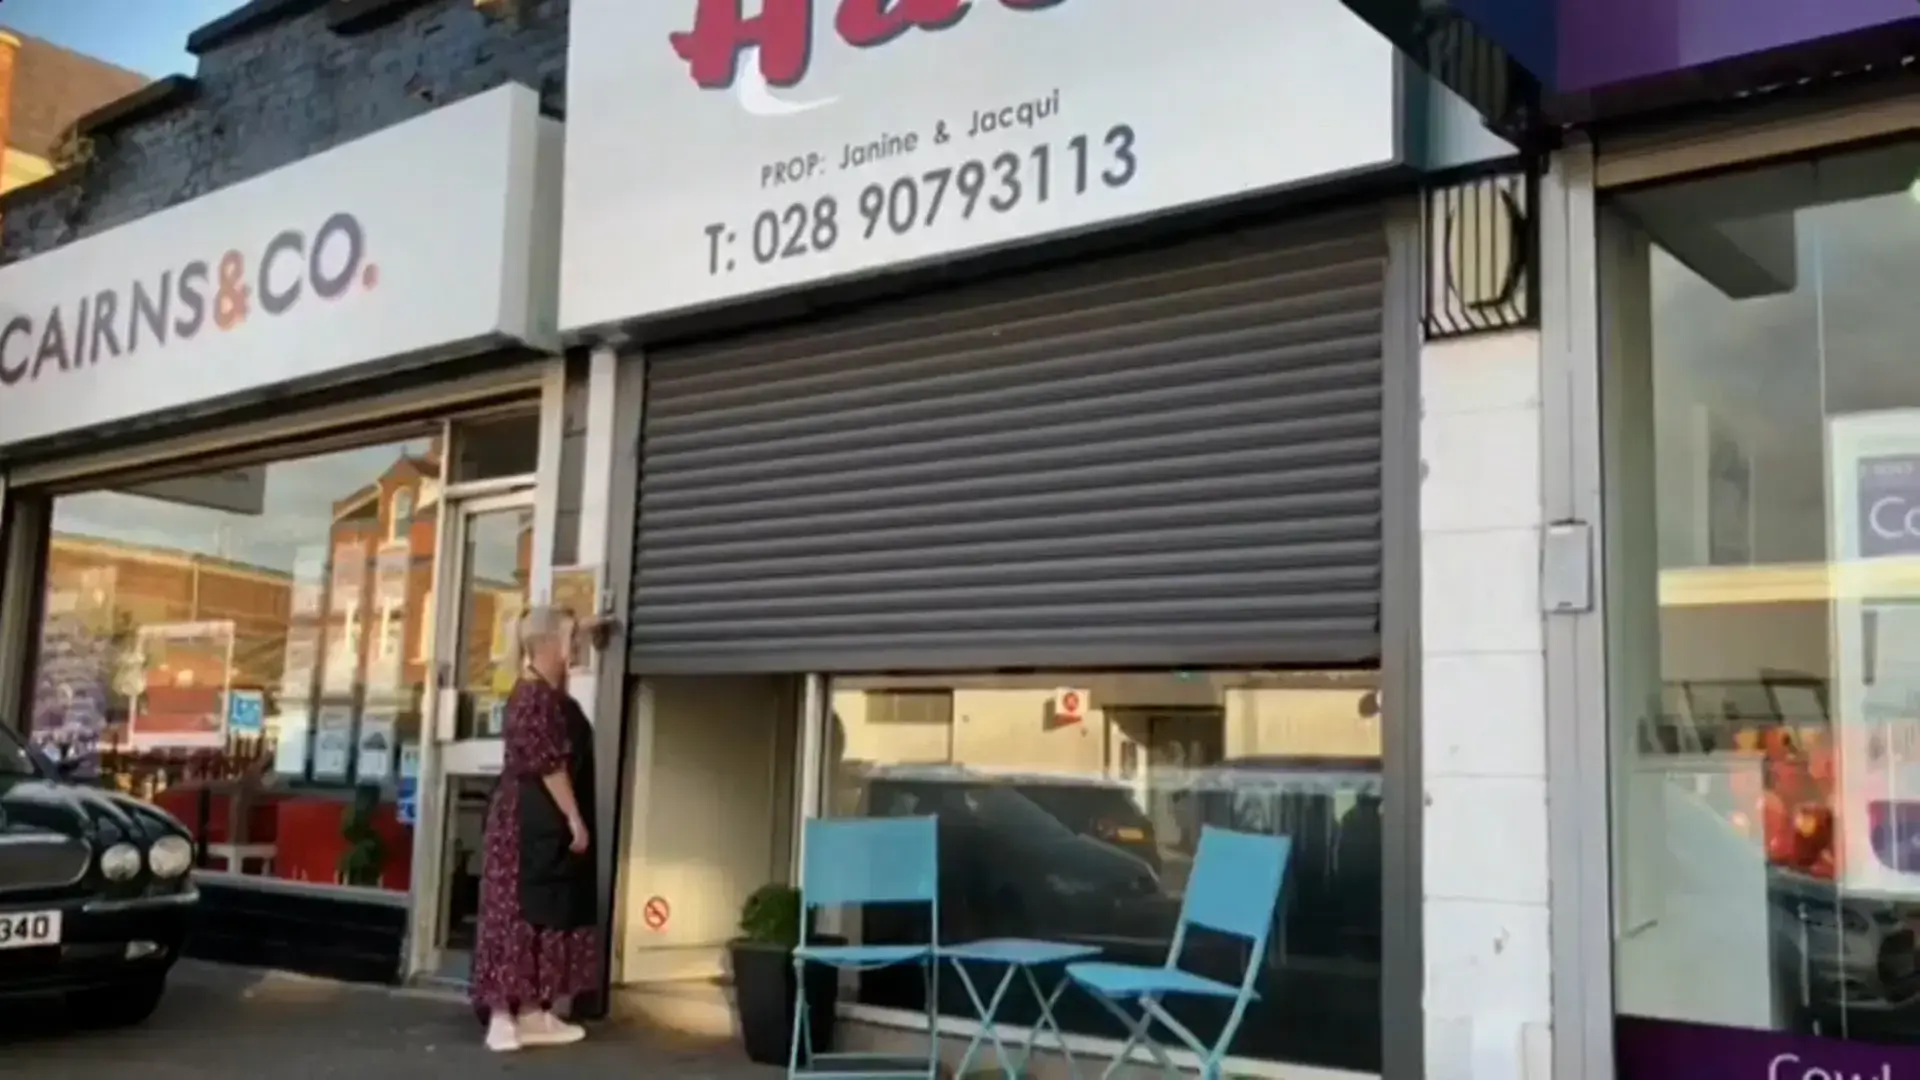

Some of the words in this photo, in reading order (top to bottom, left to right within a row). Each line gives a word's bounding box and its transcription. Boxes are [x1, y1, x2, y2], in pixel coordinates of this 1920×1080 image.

[704, 222, 736, 276] T:
[752, 196, 838, 265] 028
[858, 123, 1138, 241] 90793113
[760, 151, 826, 189] PROP:
[838, 131, 919, 170] Janine
[932, 119, 951, 144] &
[967, 88, 1060, 137] Jacqui
[0, 211, 380, 386] CAIRNS&CO.
